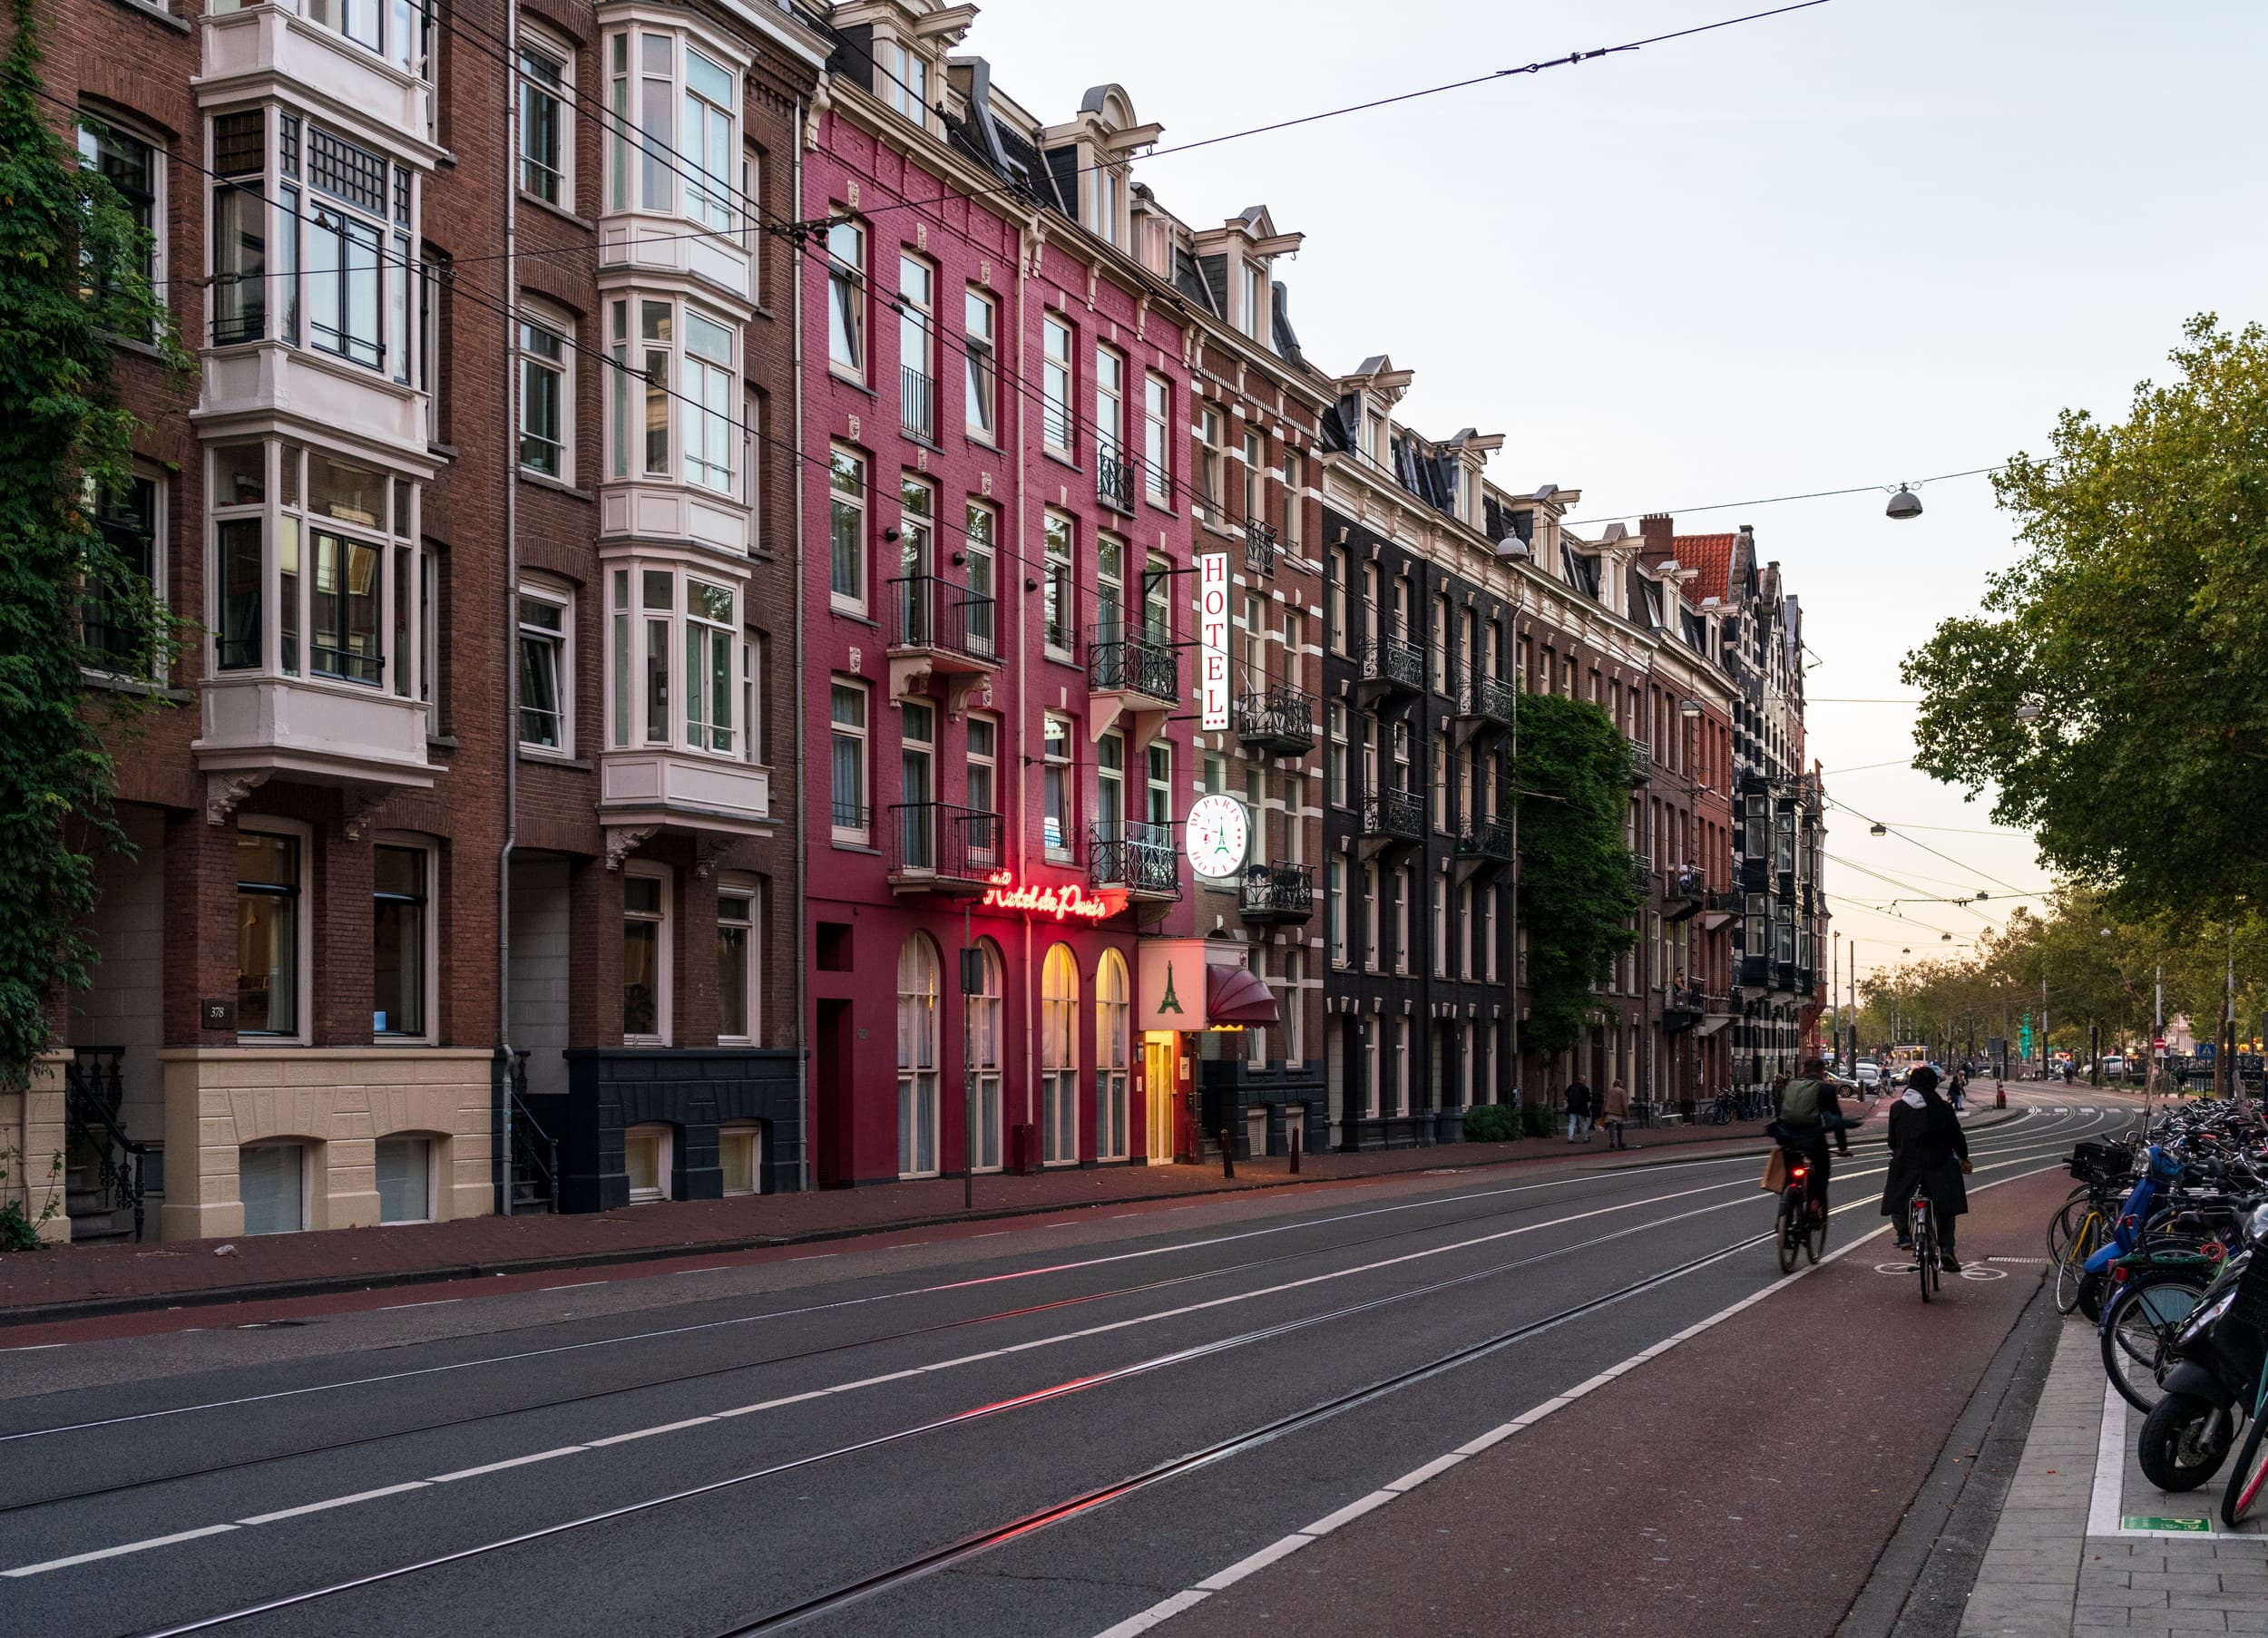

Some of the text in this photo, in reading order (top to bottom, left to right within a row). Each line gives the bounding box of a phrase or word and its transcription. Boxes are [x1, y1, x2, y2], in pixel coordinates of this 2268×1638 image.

[1205, 557, 1224, 714] HOTEL
[1189, 798, 1240, 826] DE PARIS
[1191, 851, 1238, 875] HOTEL
[1056, 884, 1106, 920] Paris
[210, 1007, 224, 1018] 378
